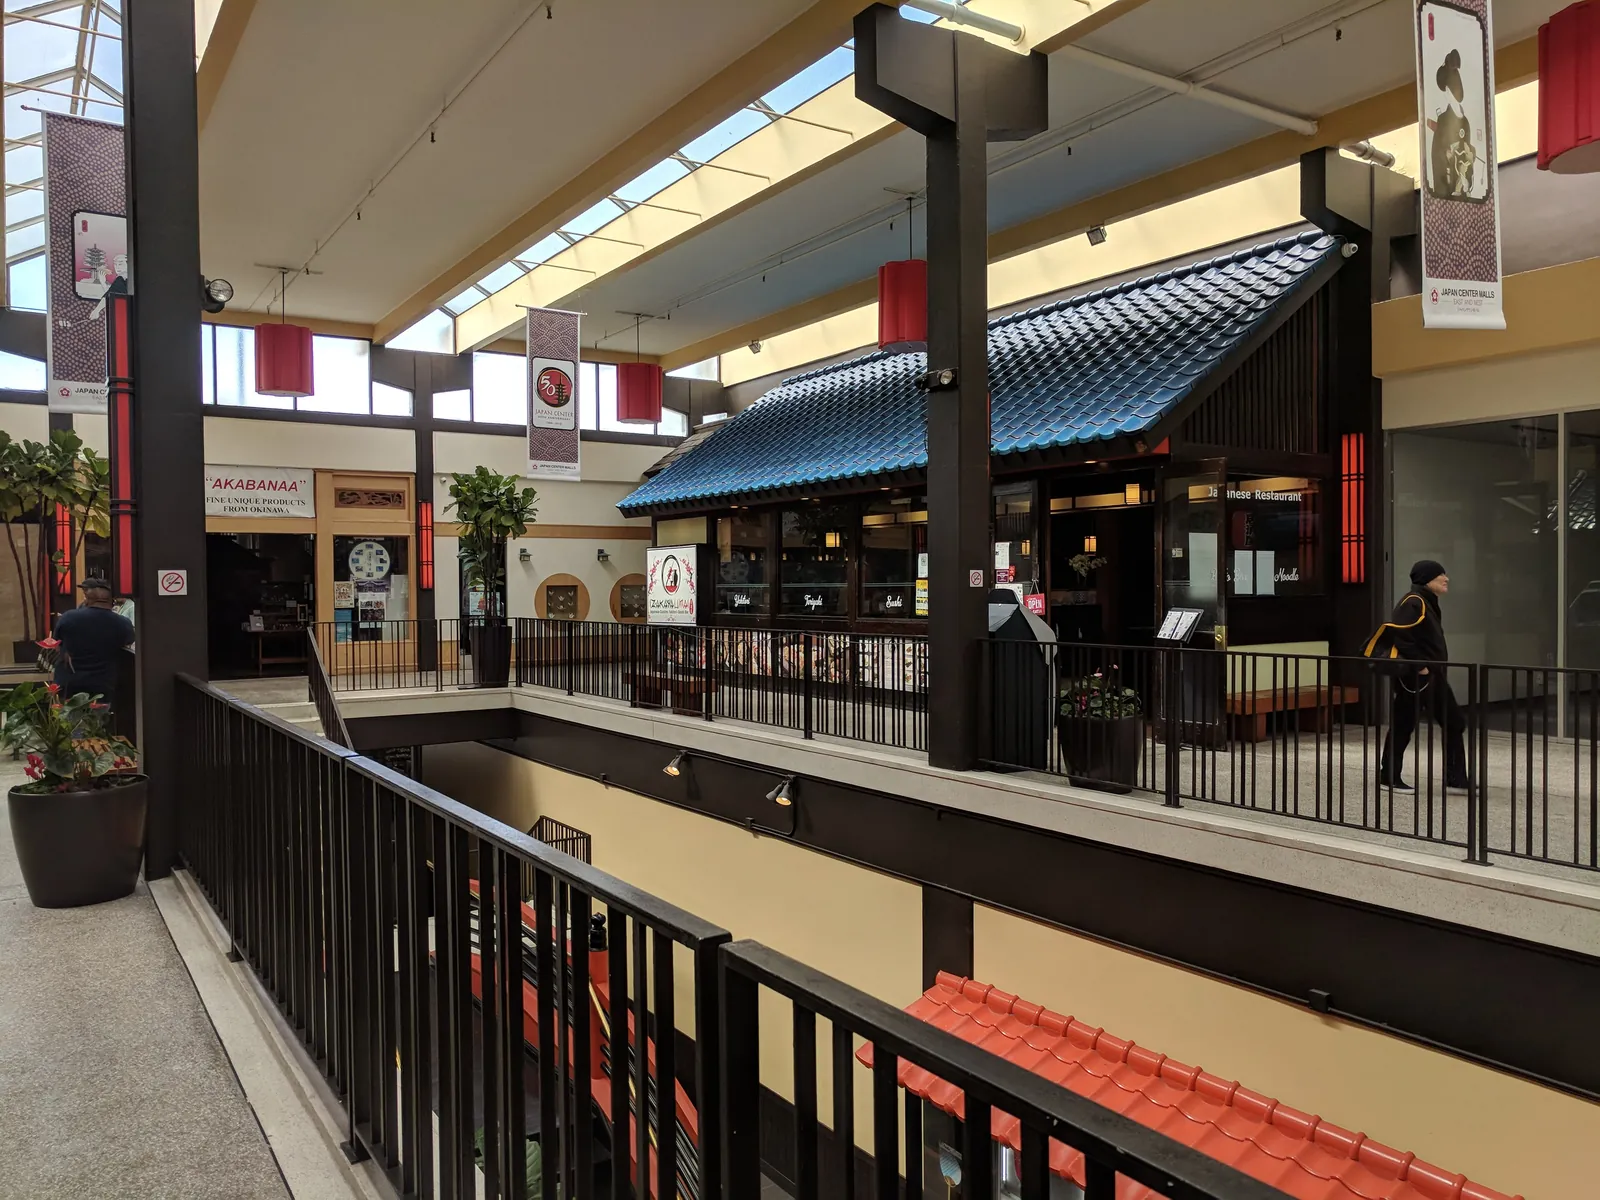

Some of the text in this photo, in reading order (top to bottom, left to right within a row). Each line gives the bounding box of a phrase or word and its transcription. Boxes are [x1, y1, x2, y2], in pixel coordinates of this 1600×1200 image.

[1441, 288, 1495, 298] JAPAN CENTER MALLS
[541, 375, 555, 396] 50
[1208, 486, 1302, 502] Jaanese Restaurant
[227, 497, 260, 505] UNIQUE
[262, 498, 306, 506] PRODUCTS
[250, 506, 290, 514] OKINAWA
[1274, 567, 1300, 582] Noodle
[886, 595, 903, 608] Sushi
[1028, 599, 1042, 610] OPEN
